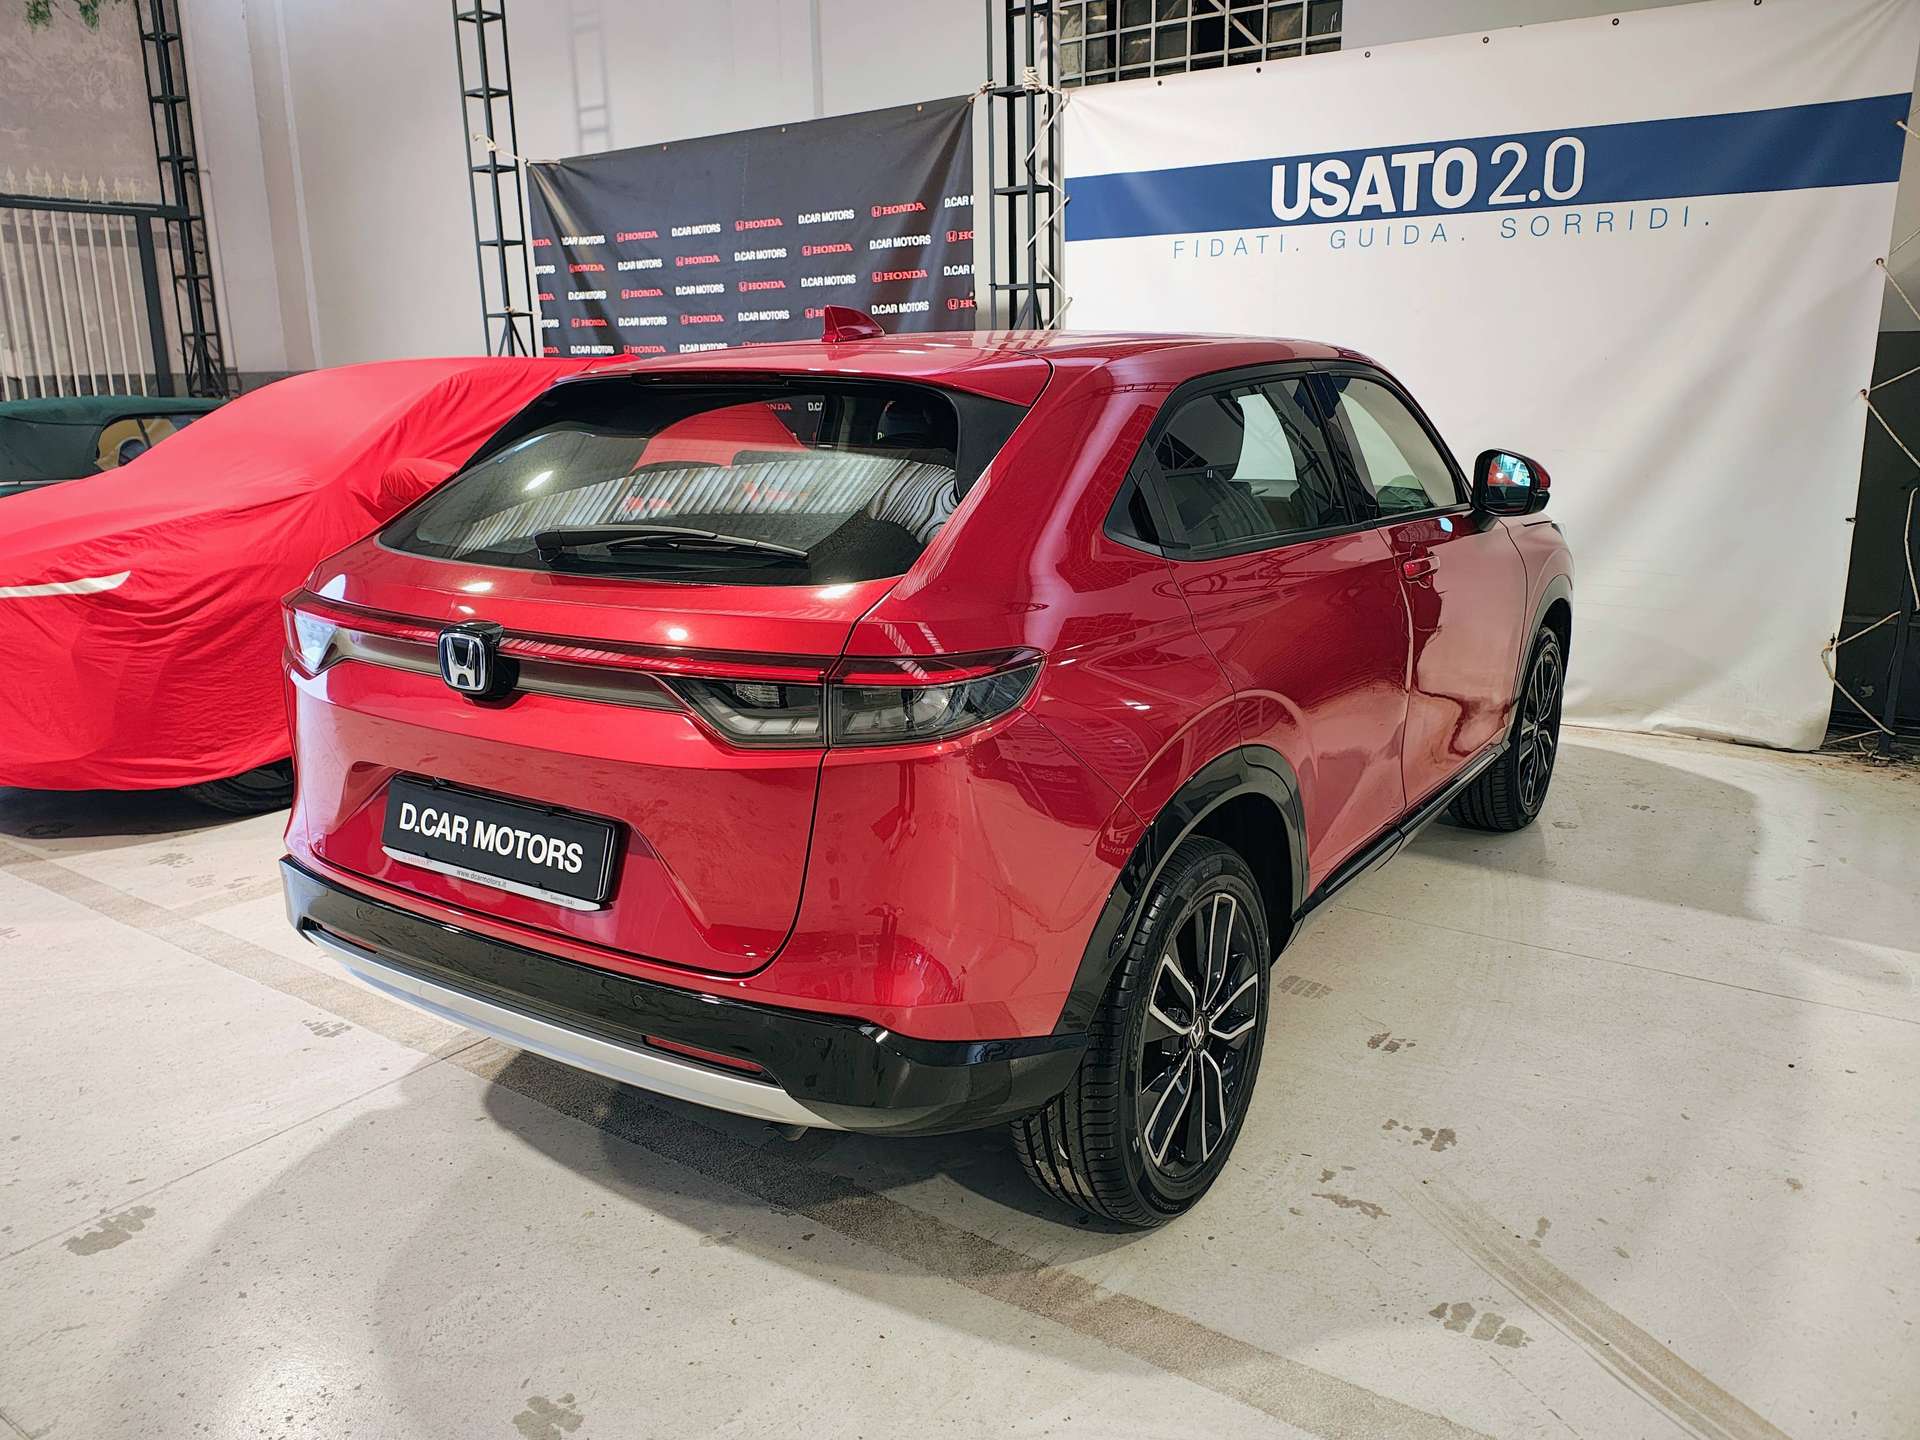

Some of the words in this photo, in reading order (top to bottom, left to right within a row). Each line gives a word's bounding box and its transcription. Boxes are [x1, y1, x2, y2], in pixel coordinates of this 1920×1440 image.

[1271, 147, 1478, 221] USATO
[1488, 136, 1586, 205] 2.0
[944, 195, 969, 208] D.CAR
[882, 202, 927, 215] HONDA
[798, 212, 821, 224] D.CAR
[821, 209, 855, 222] MOTORS
[744, 218, 783, 229] HONDA
[625, 230, 659, 241] HONDA
[671, 227, 692, 237] D.CAR
[692, 223, 721, 235] MOTORS
[1173, 234, 1299, 259] FIDATI.
[1330, 224, 1465, 249] GUIDA.
[1500, 205, 1710, 239] SORRIDI.
[533, 239, 552, 247] NDA
[869, 238, 893, 250] D.CAR
[893, 234, 932, 248] MOTORS
[734, 251, 756, 262] D.CAR
[756, 247, 787, 260] MOTORS
[812, 243, 853, 255] HONDA
[617, 260, 636, 271] D.CAR
[636, 258, 663, 269] MOTORS
[685, 254, 720, 265] HONDA
[535, 265, 556, 274] OTORS
[883, 269, 928, 281] HONDA
[944, 264, 970, 276] D.CAR
[748, 280, 786, 290] HONDA
[801, 277, 824, 288] D.CAR
[824, 274, 856, 286] MOTORS
[631, 289, 663, 298] HONDA
[675, 286, 696, 296] D.CAR
[696, 283, 725, 294] MOTORS
[871, 303, 898, 315] D.CAR
[899, 301, 929, 313] MOTORS
[618, 317, 639, 327] D.CAR
[639, 315, 668, 326] MOTORS
[689, 314, 724, 324] HONDA
[738, 311, 759, 322] D.CAR
[759, 310, 790, 320] MOTORS
[631, 345, 666, 353] HONDA
[399, 802, 470, 845] D.CAR
[473, 820, 584, 874] MOTORS
